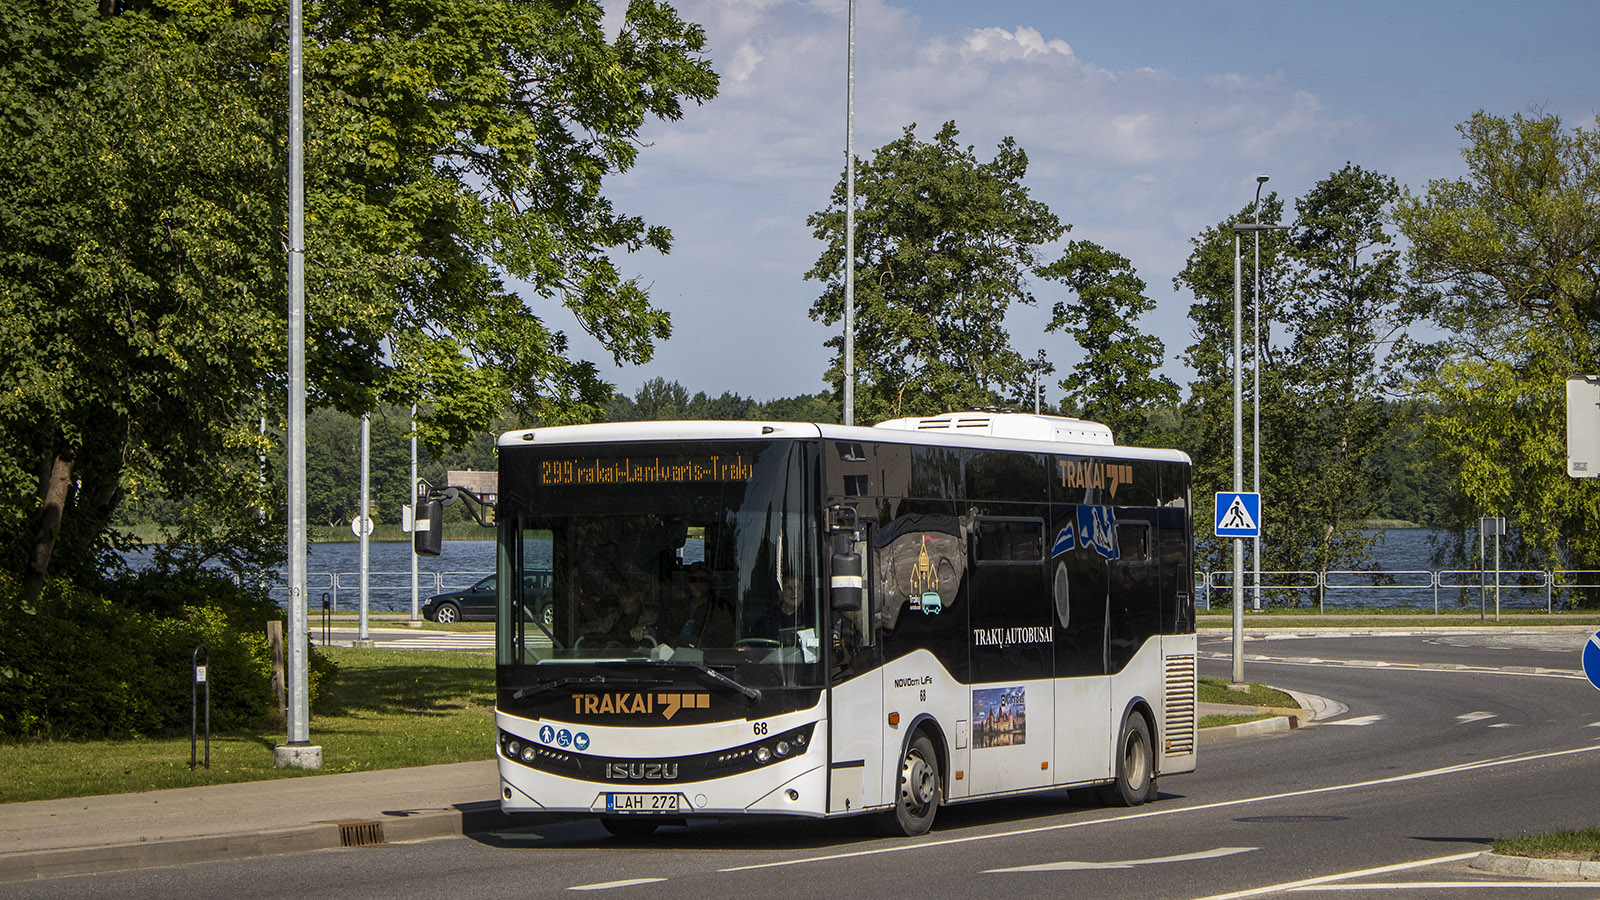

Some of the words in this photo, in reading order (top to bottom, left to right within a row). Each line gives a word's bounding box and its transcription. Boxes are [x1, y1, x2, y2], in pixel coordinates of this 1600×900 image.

[543, 461, 572, 484] 299
[1060, 460, 1105, 489] TRAKAI
[1005, 626, 1053, 644] AUTOBUSAI
[572, 693, 653, 714] TRAKAI
[920, 689, 926, 702] 68
[753, 721, 768, 736] 68
[605, 763, 678, 779] ISUZU
[615, 795, 643, 809] LAH
[651, 795, 676, 809] 272
